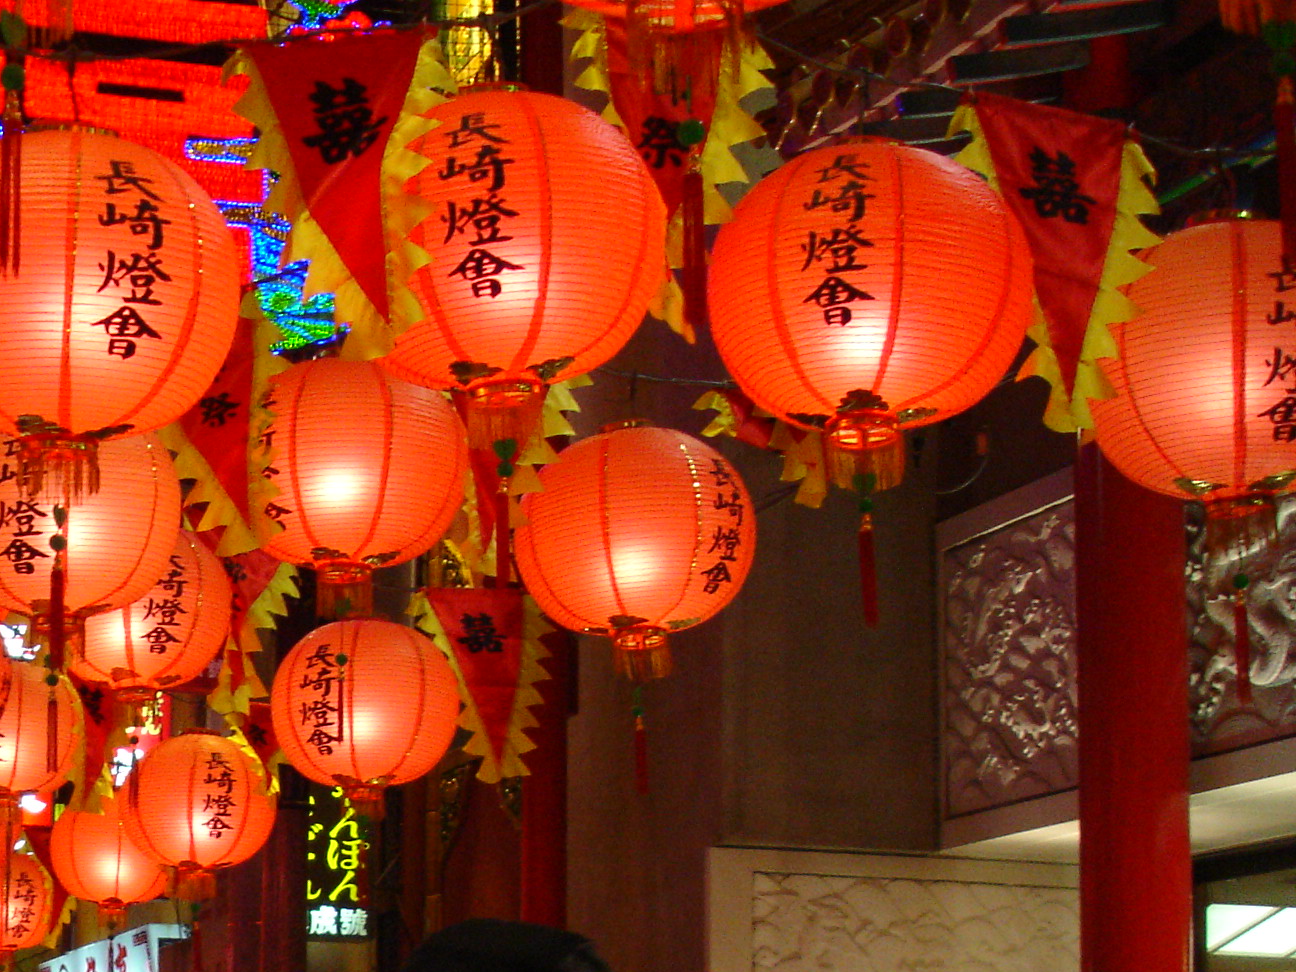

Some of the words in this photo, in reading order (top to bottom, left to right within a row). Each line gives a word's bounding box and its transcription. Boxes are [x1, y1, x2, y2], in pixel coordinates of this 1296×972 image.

[91, 159, 173, 361] 長崎燈會
[438, 110, 523, 299] 長崎燈會
[800, 153, 876, 327] 長崎燈會
[299, 644, 340, 756] 長崎燈會
[203, 751, 239, 840] 長崎燈會
